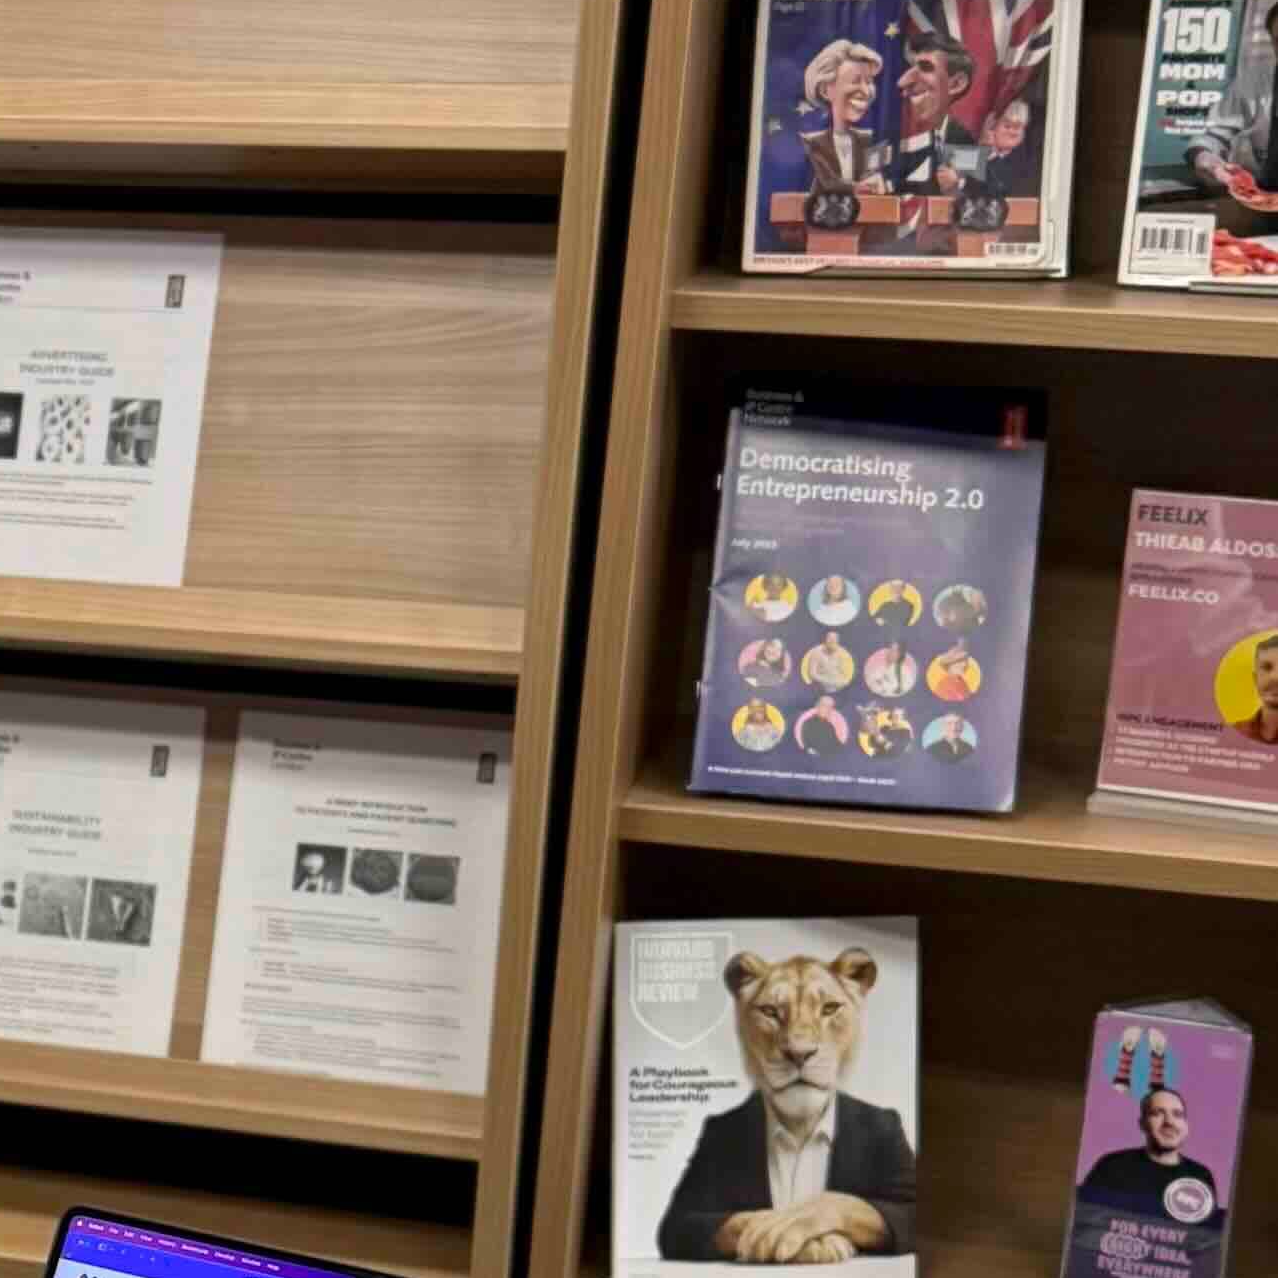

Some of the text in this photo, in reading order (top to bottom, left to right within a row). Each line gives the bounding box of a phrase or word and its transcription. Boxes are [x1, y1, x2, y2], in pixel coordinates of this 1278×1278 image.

[1163, 8, 1231, 52] 150
[1159, 63, 1225, 79] MOM
[1156, 91, 1222, 106] POP
[740, 447, 912, 482] Democratising
[738, 474, 983, 512] Entrepreneurship 2.0
[1139, 506, 1207, 525] FEELIX
[630, 1067, 709, 1078] A Playbook
[630, 1079, 737, 1090] for Courageous
[629, 1092, 710, 1104] Leadership
